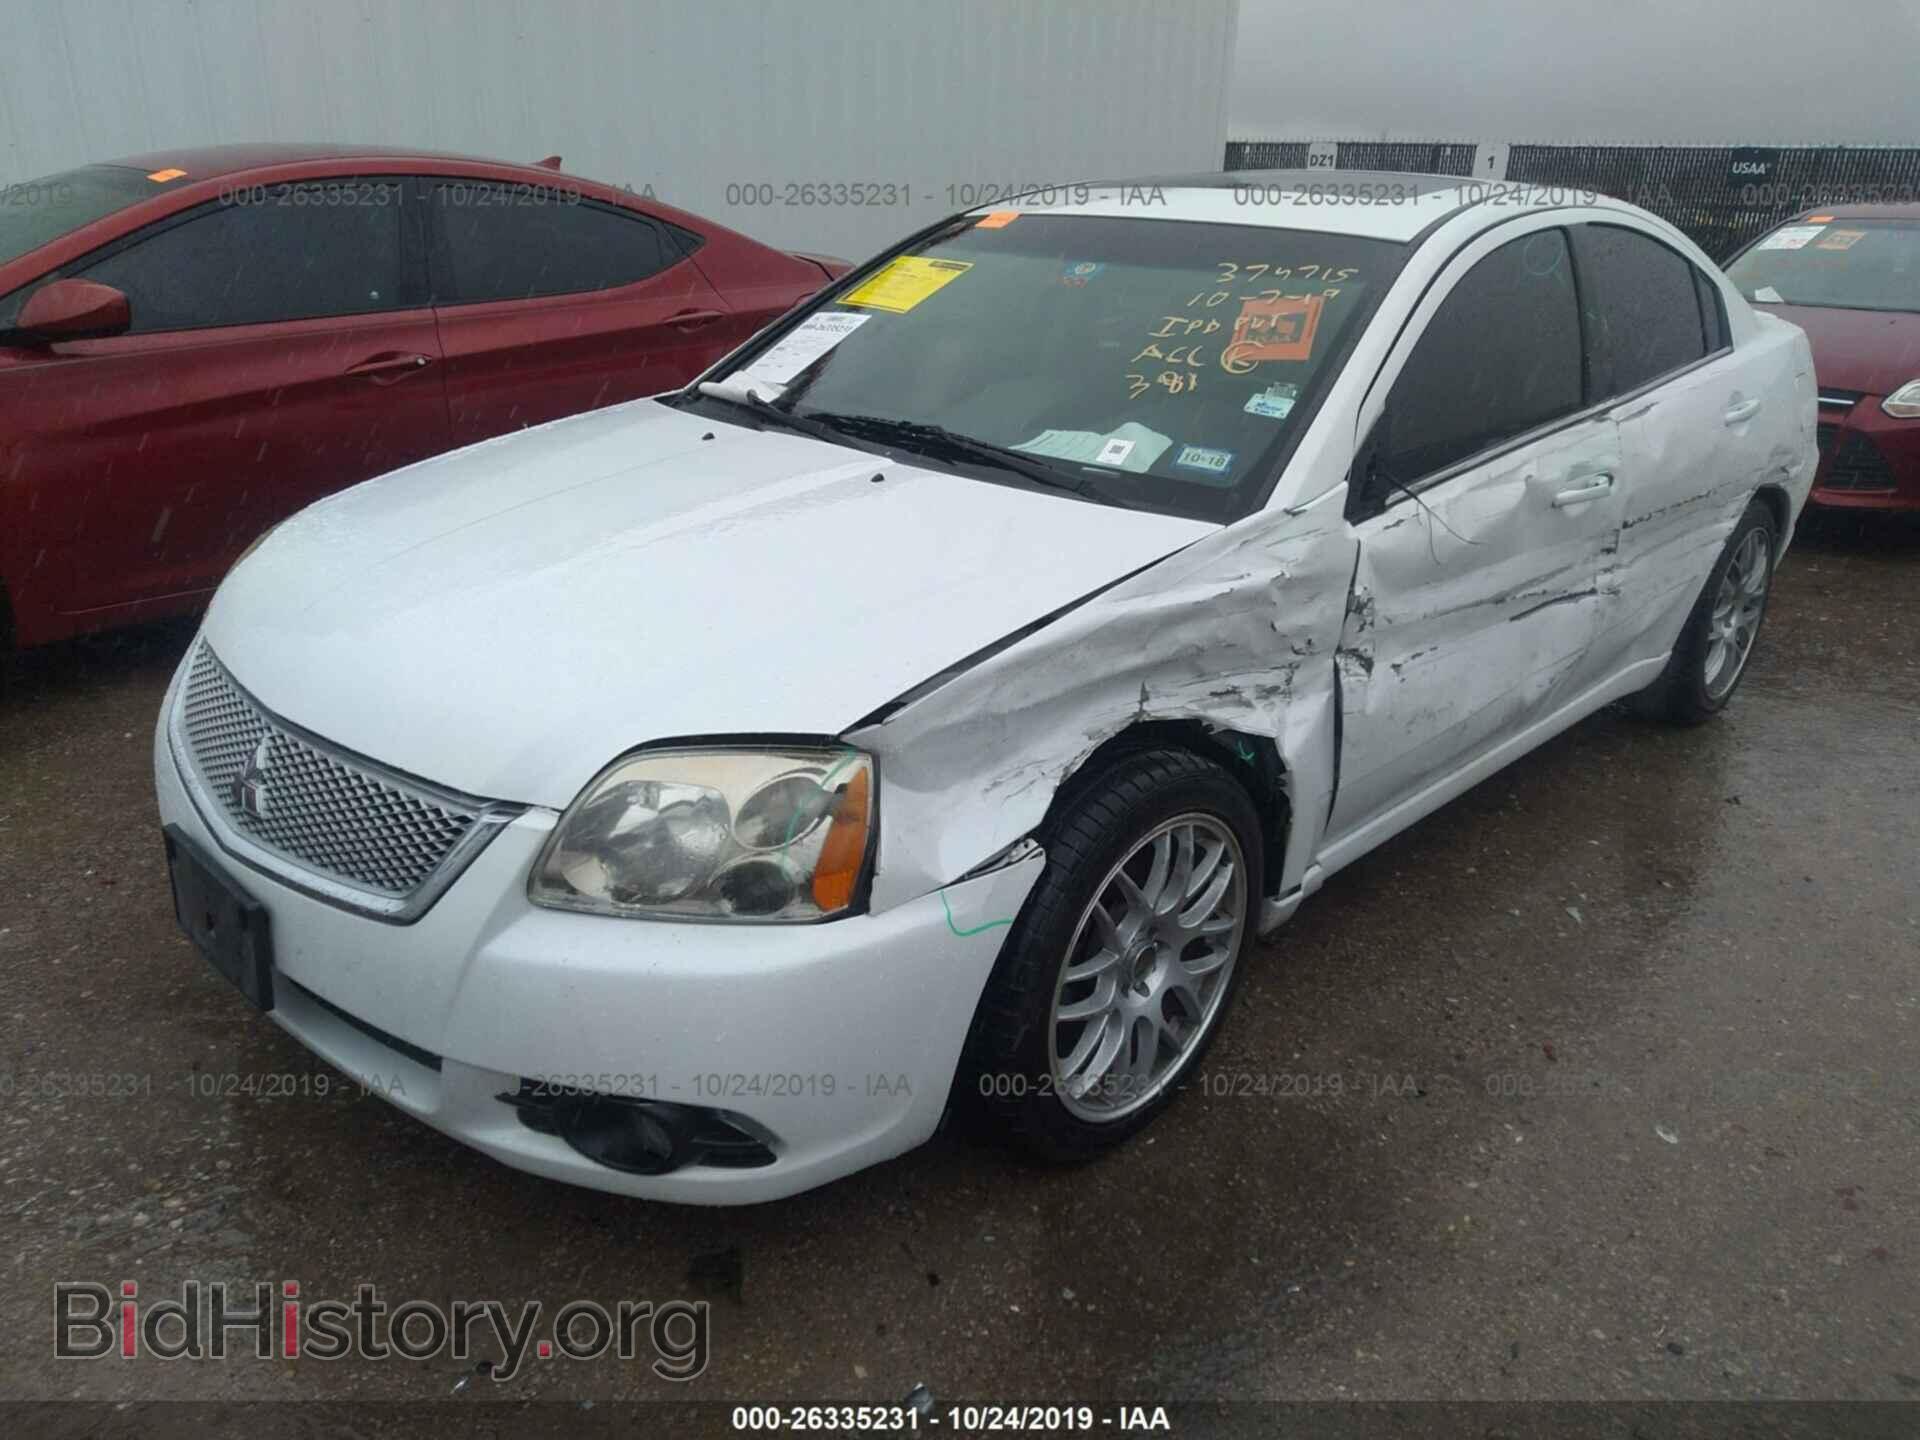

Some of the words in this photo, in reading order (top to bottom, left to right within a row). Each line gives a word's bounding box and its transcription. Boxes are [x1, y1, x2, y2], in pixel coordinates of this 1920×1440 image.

[1309, 154, 1335, 168] DZ1
[1487, 155, 1496, 169] 1
[1732, 162, 1766, 175] USAA
